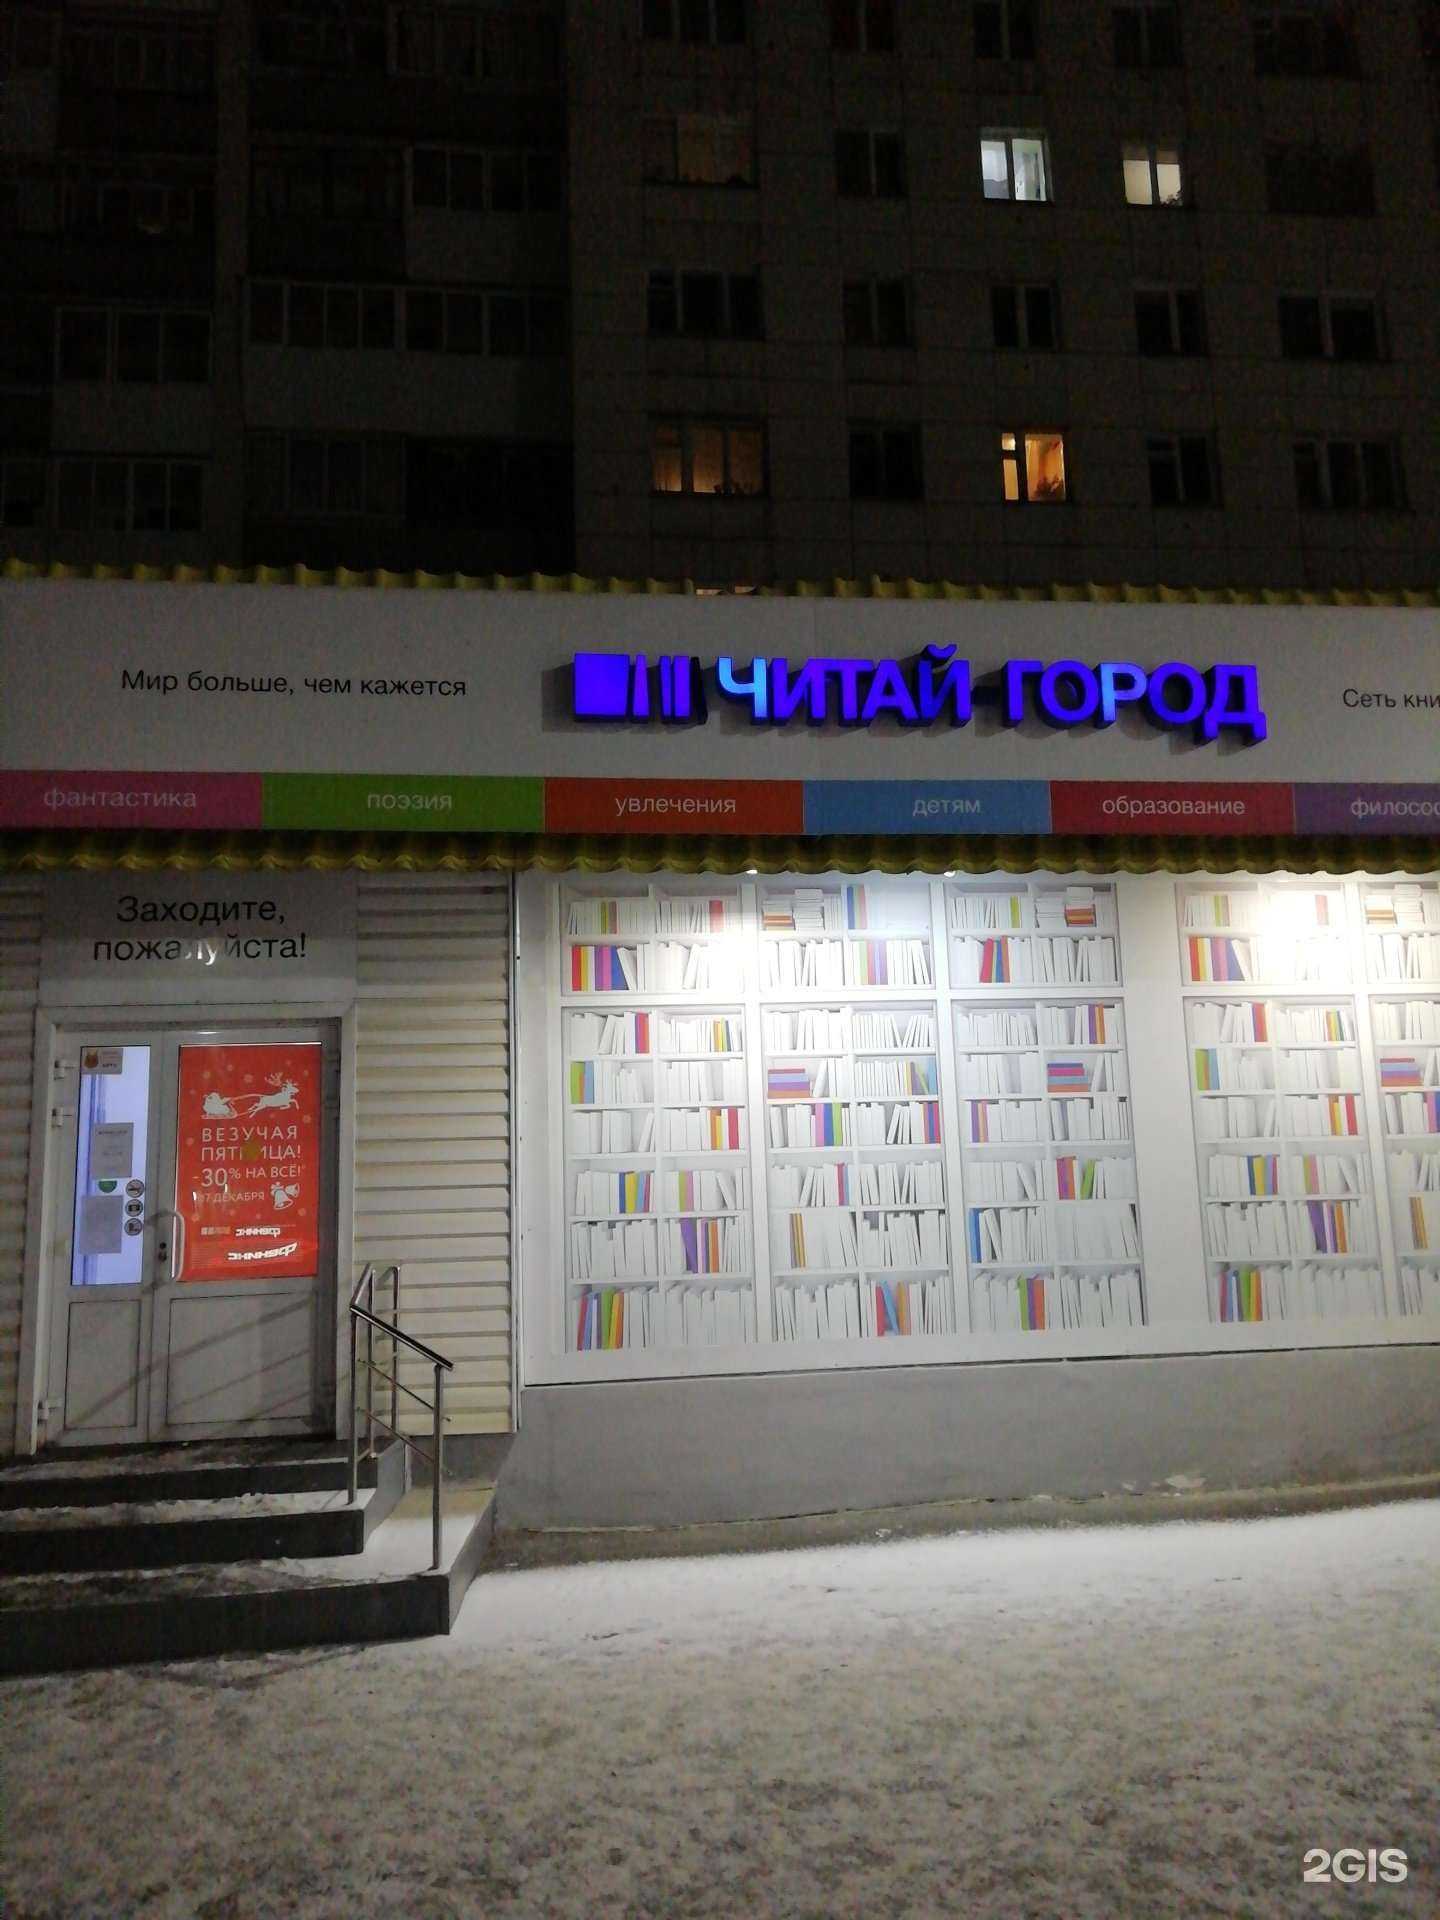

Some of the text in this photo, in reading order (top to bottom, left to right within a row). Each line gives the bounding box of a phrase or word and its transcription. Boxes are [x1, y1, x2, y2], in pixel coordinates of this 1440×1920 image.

[120, 669, 467, 696] Мир больше, чем кажется
[1342, 688, 1397, 708] Сеть
[43, 787, 198, 810] фантастика
[366, 792, 453, 811] поэзия
[615, 797, 738, 816] увлечения
[912, 798, 981, 816] детям
[1101, 795, 1246, 818] образование
[116, 896, 286, 926] Заходите,
[201, 1125, 297, 1142] ВЕЗУЧАЯ
[245, 1167, 267, 1178] НА
